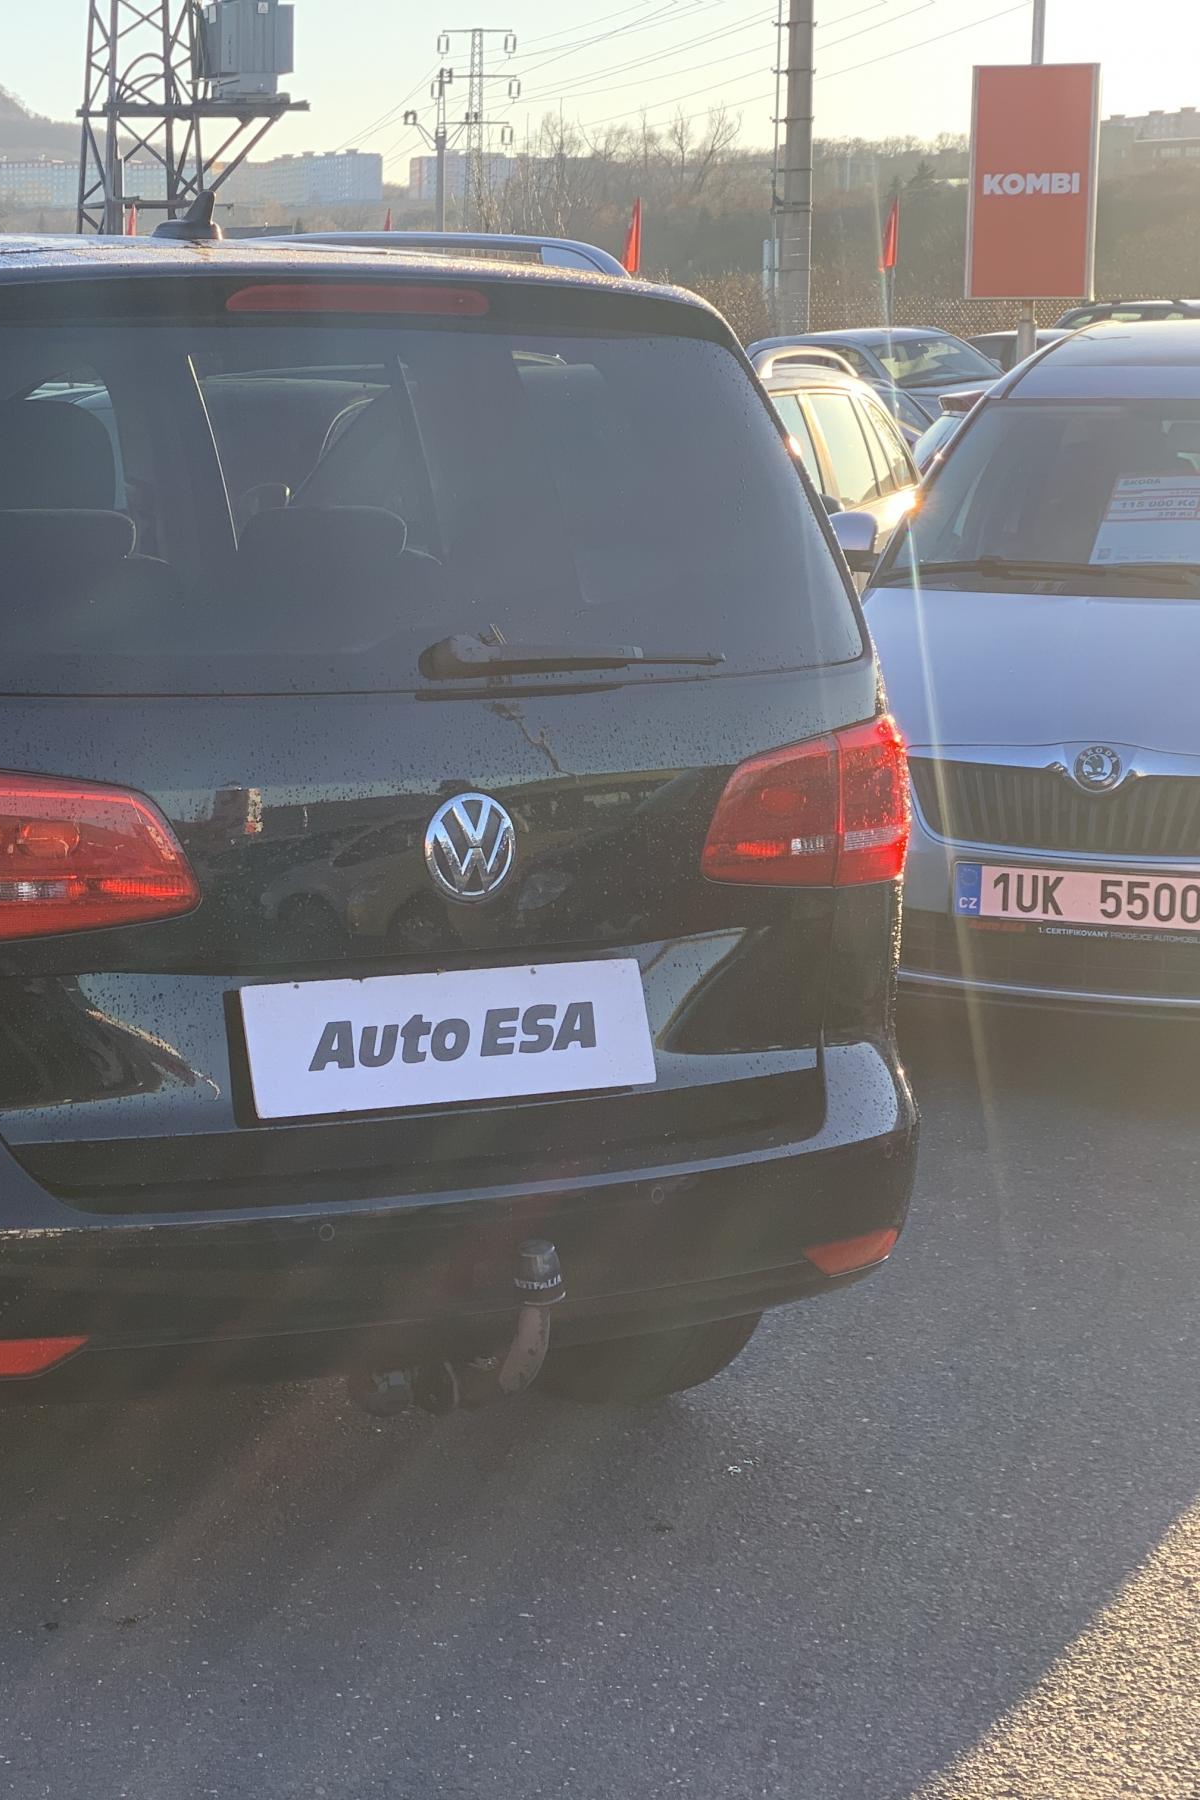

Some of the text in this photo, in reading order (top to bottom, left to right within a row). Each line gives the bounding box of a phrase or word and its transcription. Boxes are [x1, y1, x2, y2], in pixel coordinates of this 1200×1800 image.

[983, 172, 1081, 195] KOMBI
[958, 872, 1200, 924] CZ 1UK 5500
[308, 1001, 597, 1072] Auto ESA
